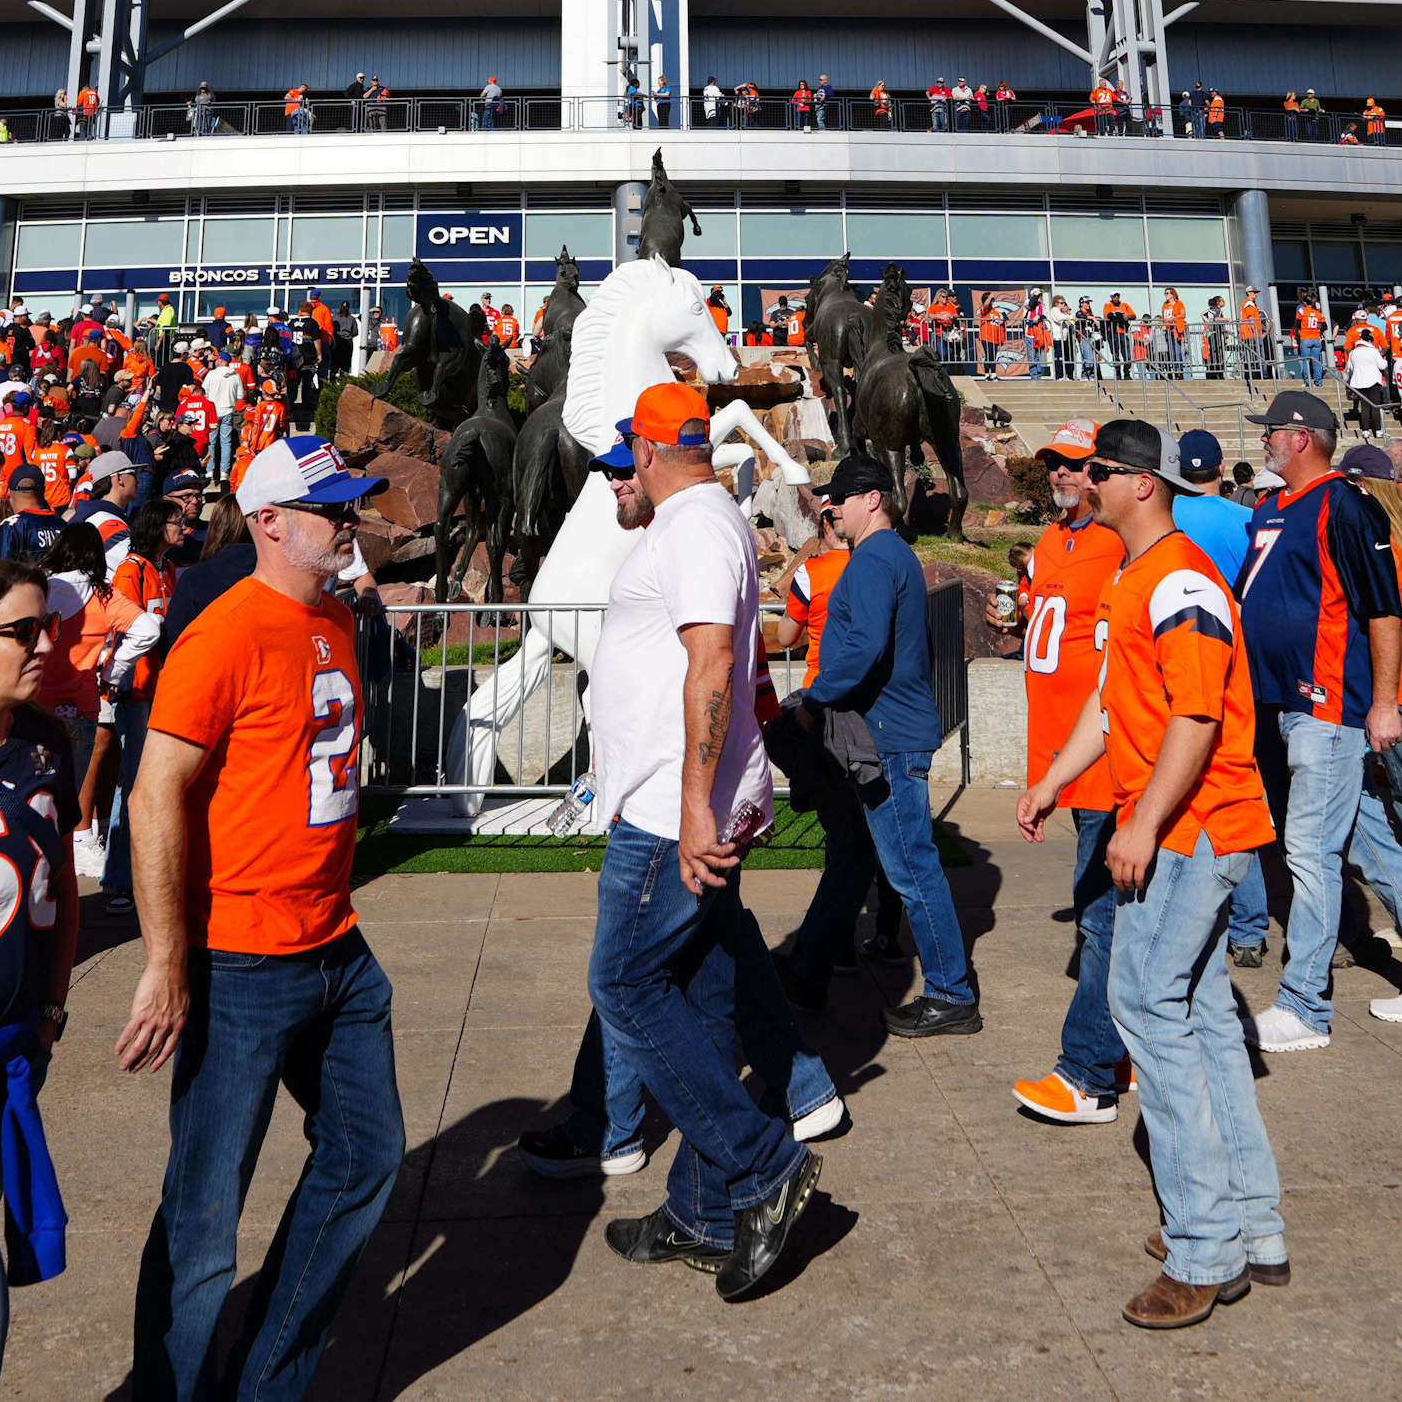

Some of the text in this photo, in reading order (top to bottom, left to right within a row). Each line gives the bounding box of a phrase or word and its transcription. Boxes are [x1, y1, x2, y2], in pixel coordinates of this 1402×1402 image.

[428, 226, 510, 245] OPEN
[169, 266, 391, 284] BRONCOS TEAM STORE
[501, 323, 514, 336] 15
[1242, 527, 1283, 601] 7
[307, 667, 358, 828] 2
